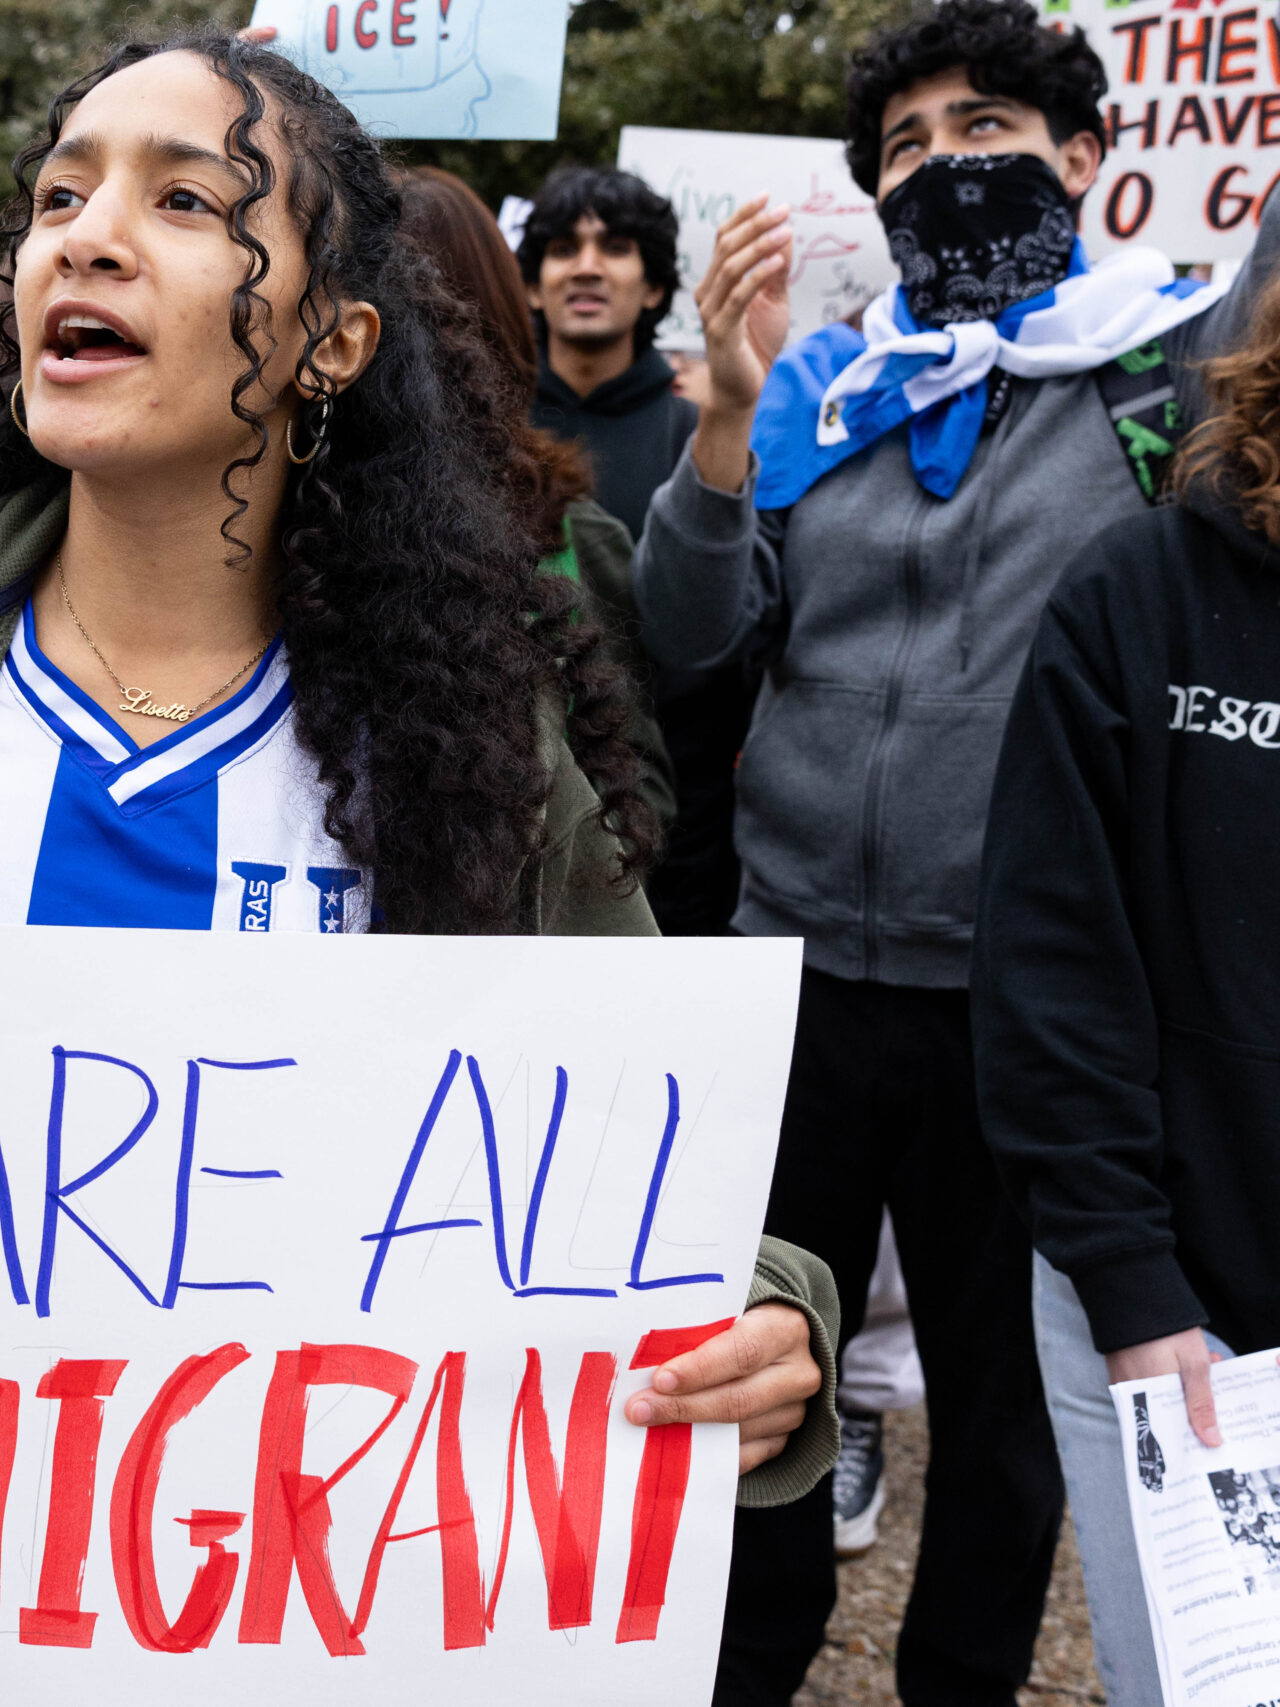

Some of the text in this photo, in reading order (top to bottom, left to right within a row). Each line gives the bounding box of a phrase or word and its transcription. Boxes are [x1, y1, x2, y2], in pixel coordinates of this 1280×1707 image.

[325, 0, 449, 52] ICE!
[1112, 8, 1280, 85] THE
[119, 687, 190, 722] Lisette
[360, 1048, 725, 1312] ALL
